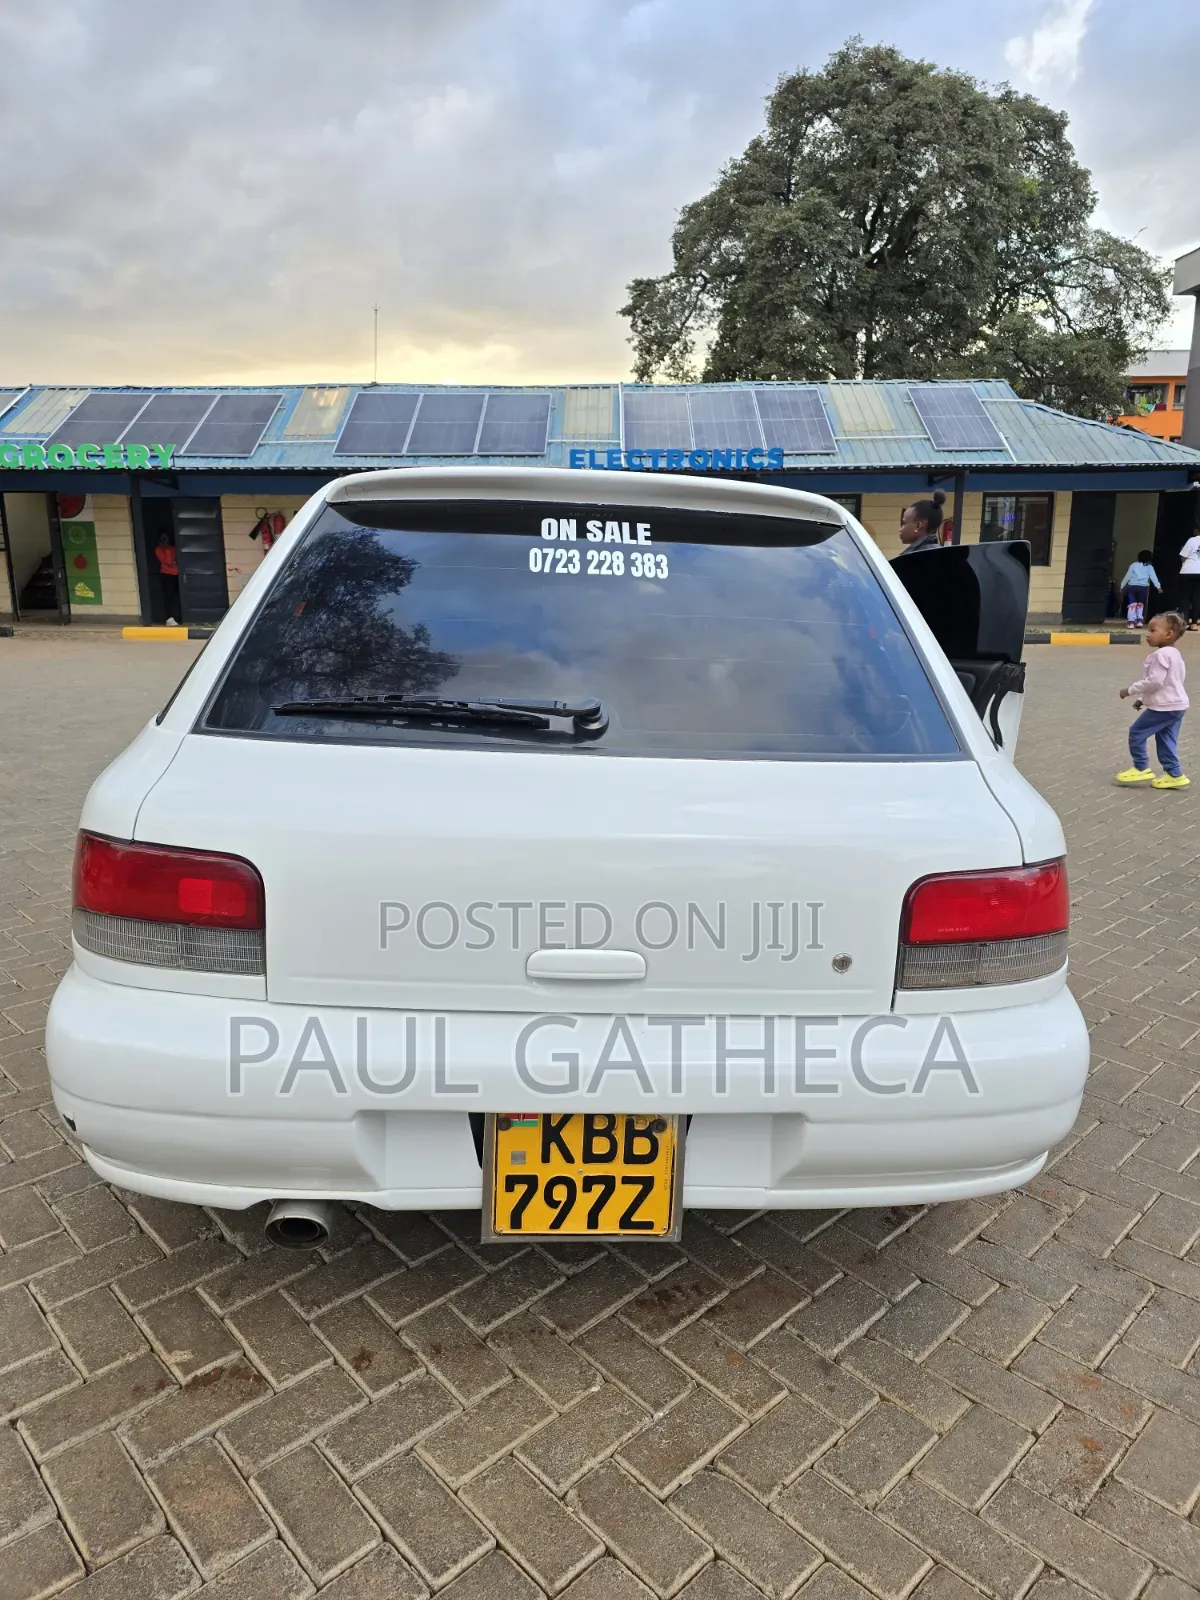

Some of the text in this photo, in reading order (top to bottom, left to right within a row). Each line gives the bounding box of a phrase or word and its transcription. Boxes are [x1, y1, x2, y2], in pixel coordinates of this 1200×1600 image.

[0, 443, 176, 470] GROCERY
[569, 447, 784, 470] ELECTRONICS
[541, 518, 652, 545] ON SALE
[529, 547, 669, 579] 0723 228 383
[541, 1113, 659, 1164] KBB
[505, 1174, 655, 1230] 797Z
